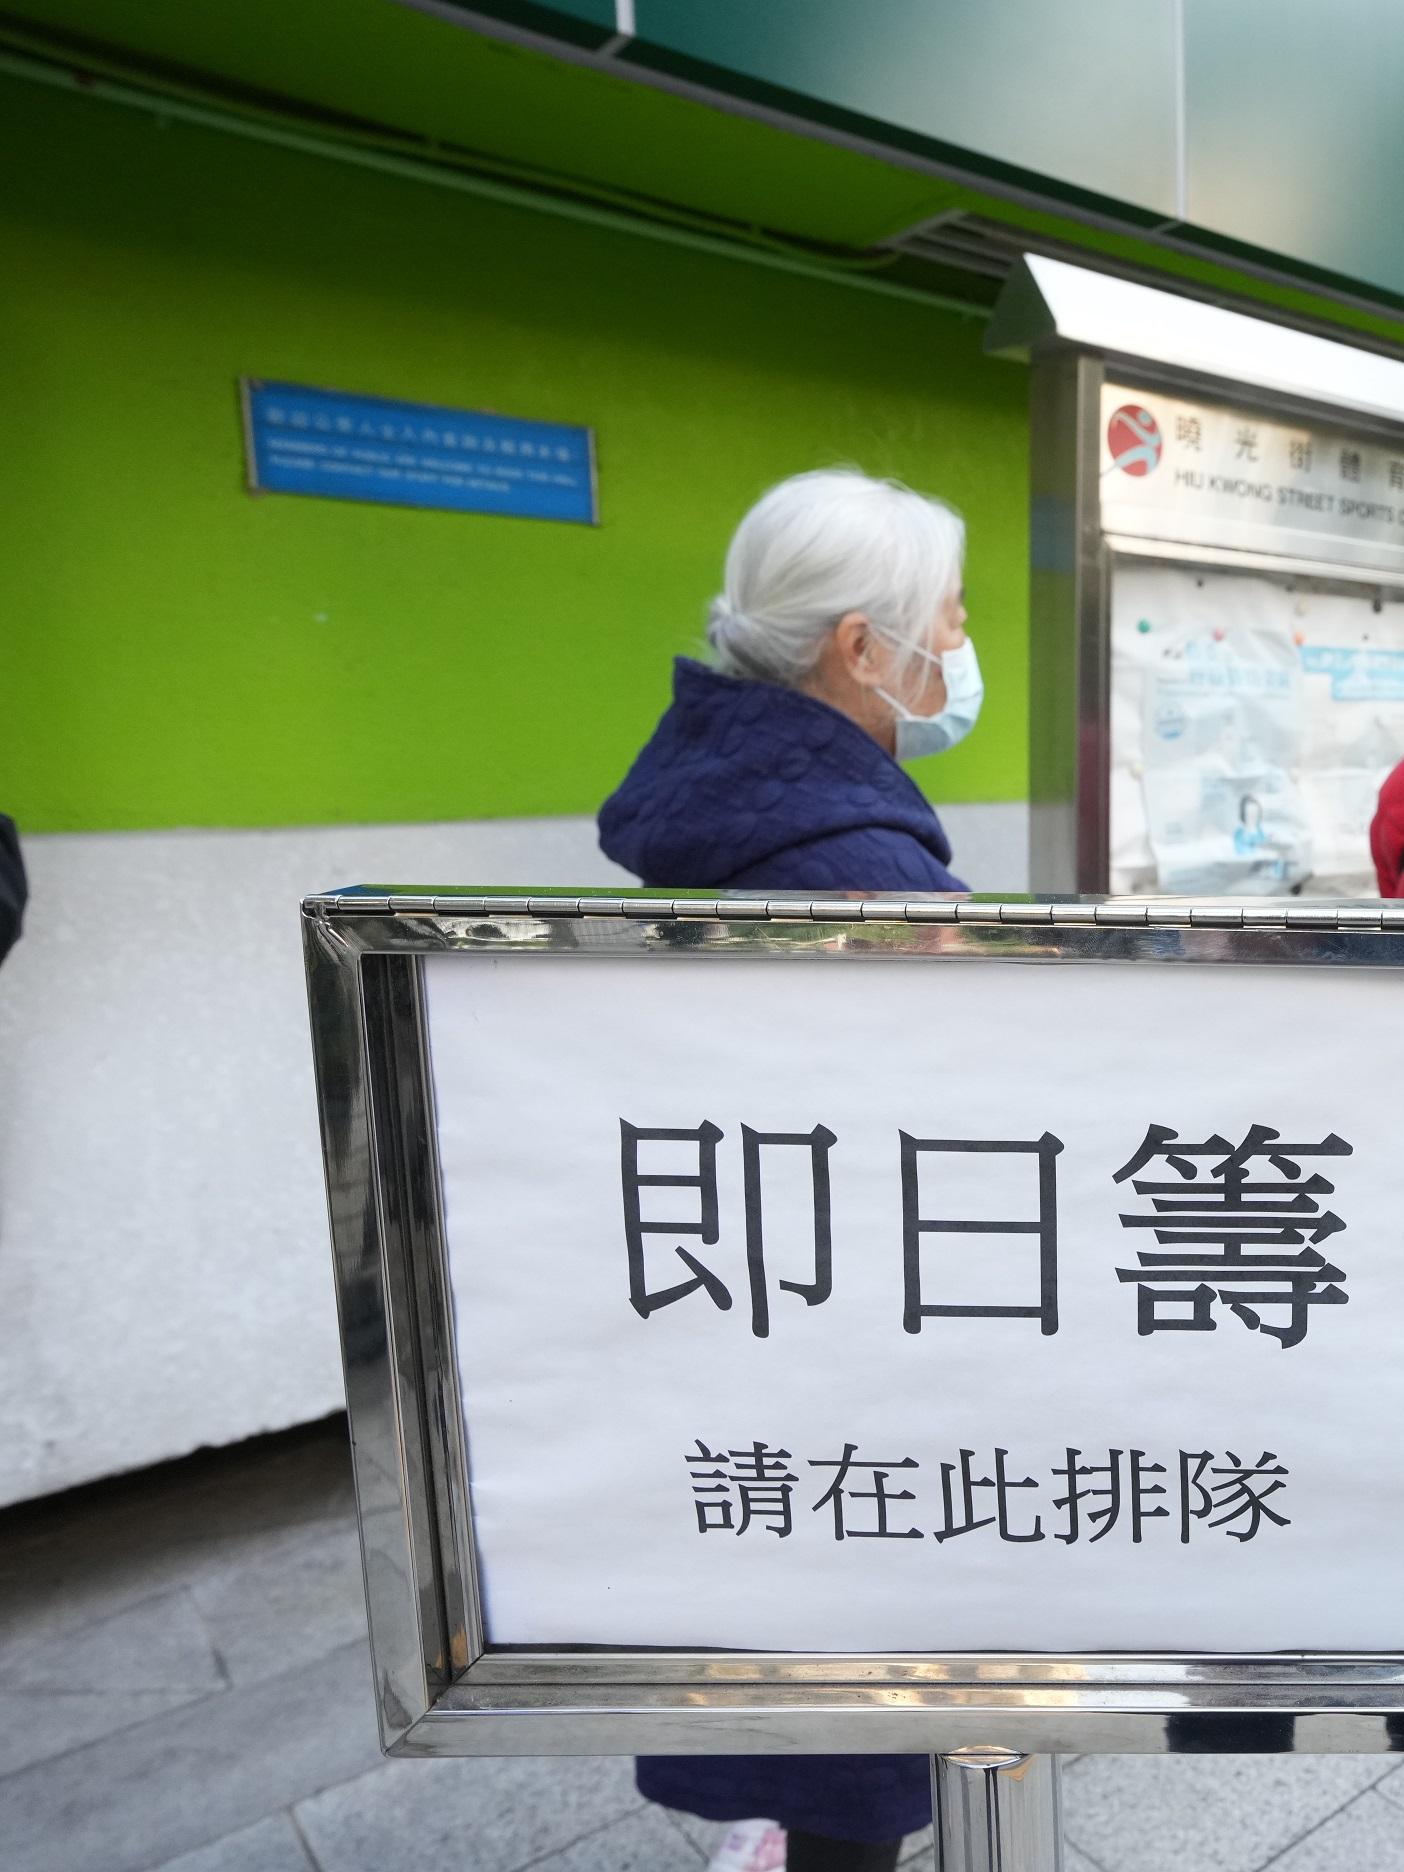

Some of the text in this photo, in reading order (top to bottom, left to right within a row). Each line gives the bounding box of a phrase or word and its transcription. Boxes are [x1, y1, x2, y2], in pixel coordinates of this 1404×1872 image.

[1208, 474, 1273, 502] KWONG
[1277, 485, 1335, 513] STREET
[1339, 496, 1394, 525] SPORTS
[619, 1117, 1354, 1349] 即日籌
[684, 1439, 1291, 1544] 請在此排隊
